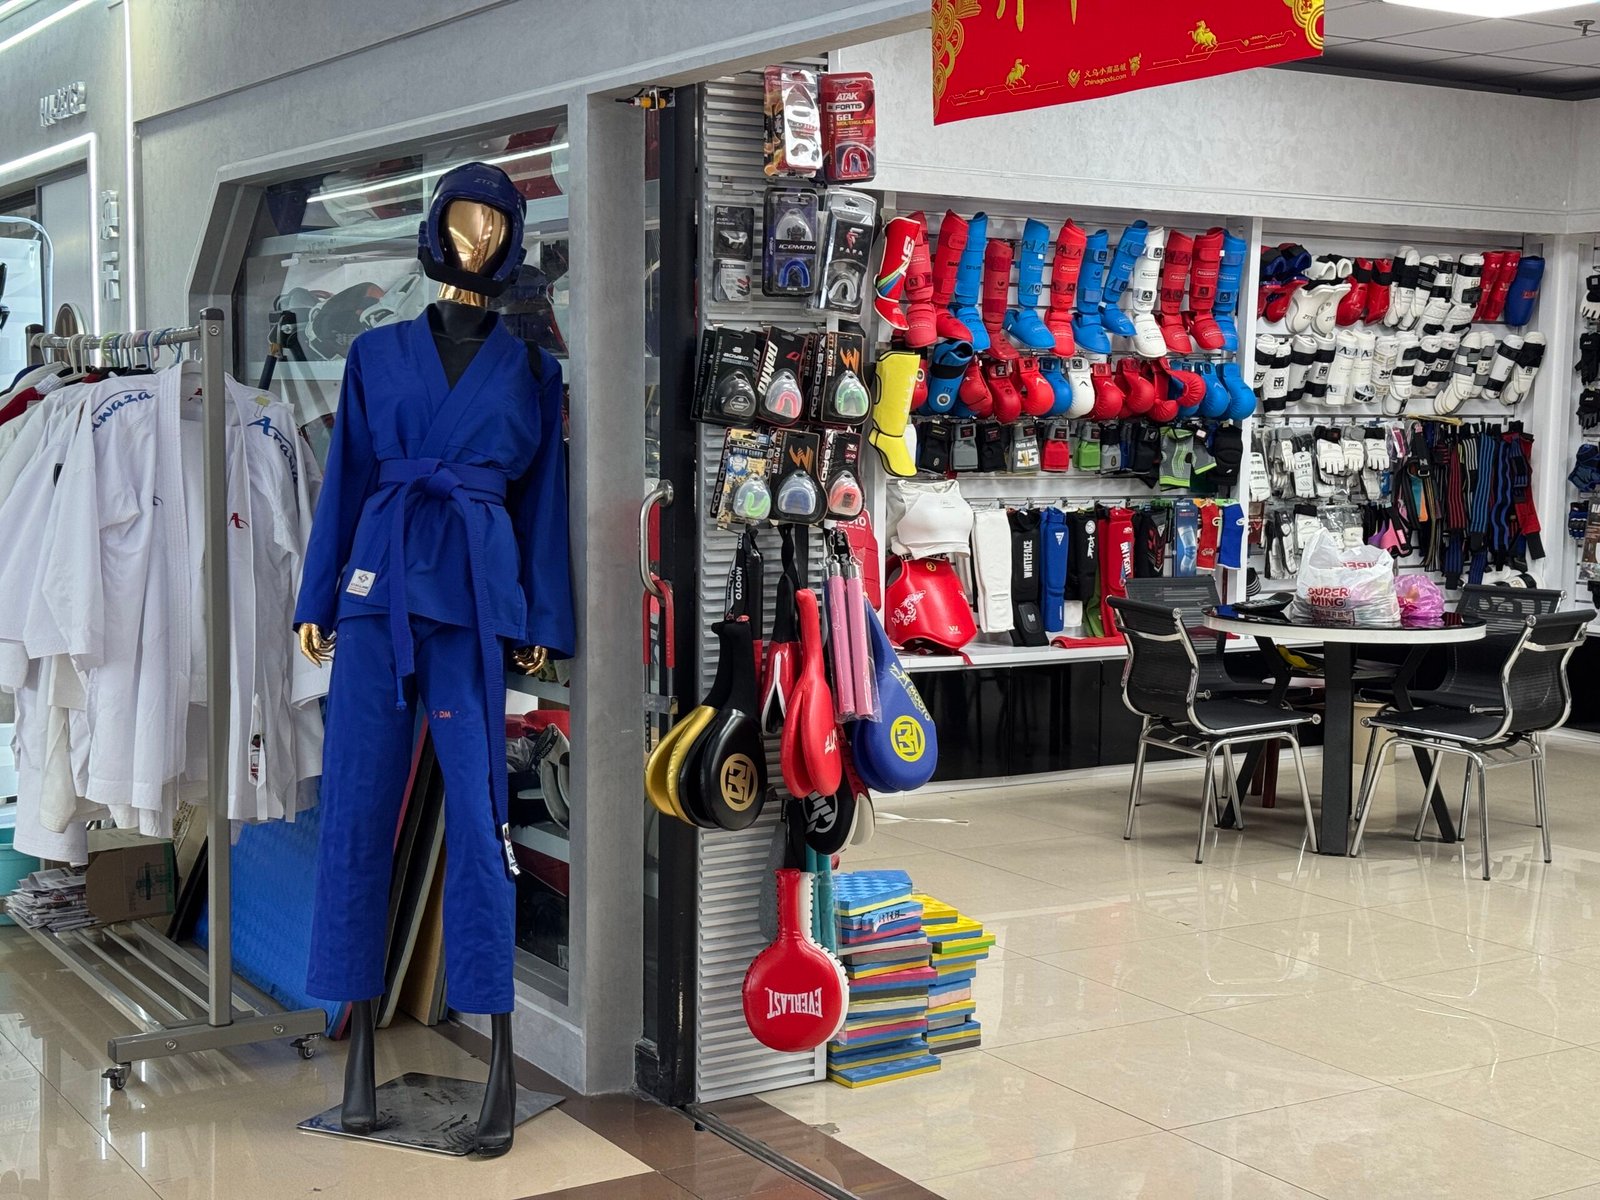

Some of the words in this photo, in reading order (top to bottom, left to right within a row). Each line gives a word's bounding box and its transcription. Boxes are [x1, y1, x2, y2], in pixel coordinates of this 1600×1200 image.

[1084, 74, 1127, 86] Chinagoods.com
[836, 92, 858, 101] ATAK
[772, 447, 780, 474] POWER
[1023, 540, 1033, 579] WHITEFACE
[1308, 587, 1350, 598] SUPER
[1311, 596, 1346, 607] MING
[909, 685, 931, 722] MOOTO
[766, 986, 823, 1019] EVERLAST
